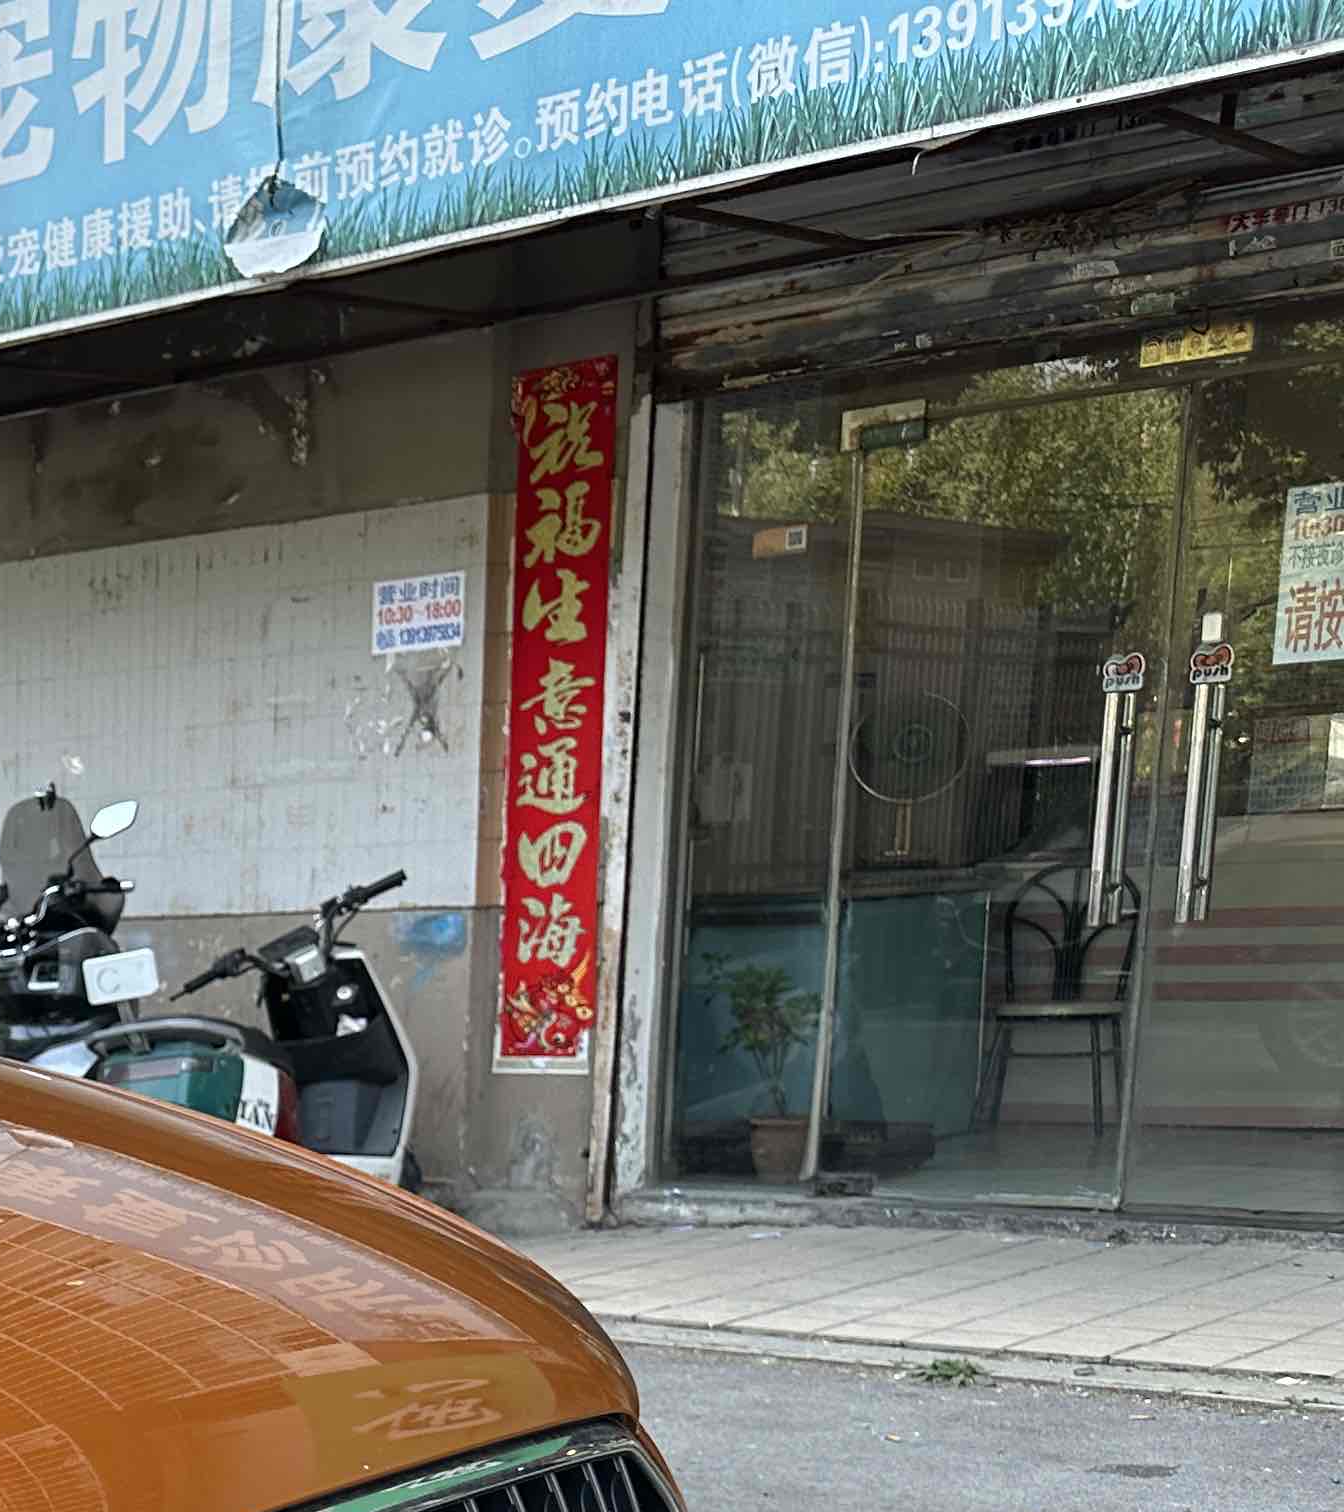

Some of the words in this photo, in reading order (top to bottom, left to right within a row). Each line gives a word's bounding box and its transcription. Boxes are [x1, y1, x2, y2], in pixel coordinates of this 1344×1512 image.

[378, 576, 460, 605] 营业时间
[1192, 663, 1229, 681] push
[1105, 675, 1141, 689] push
